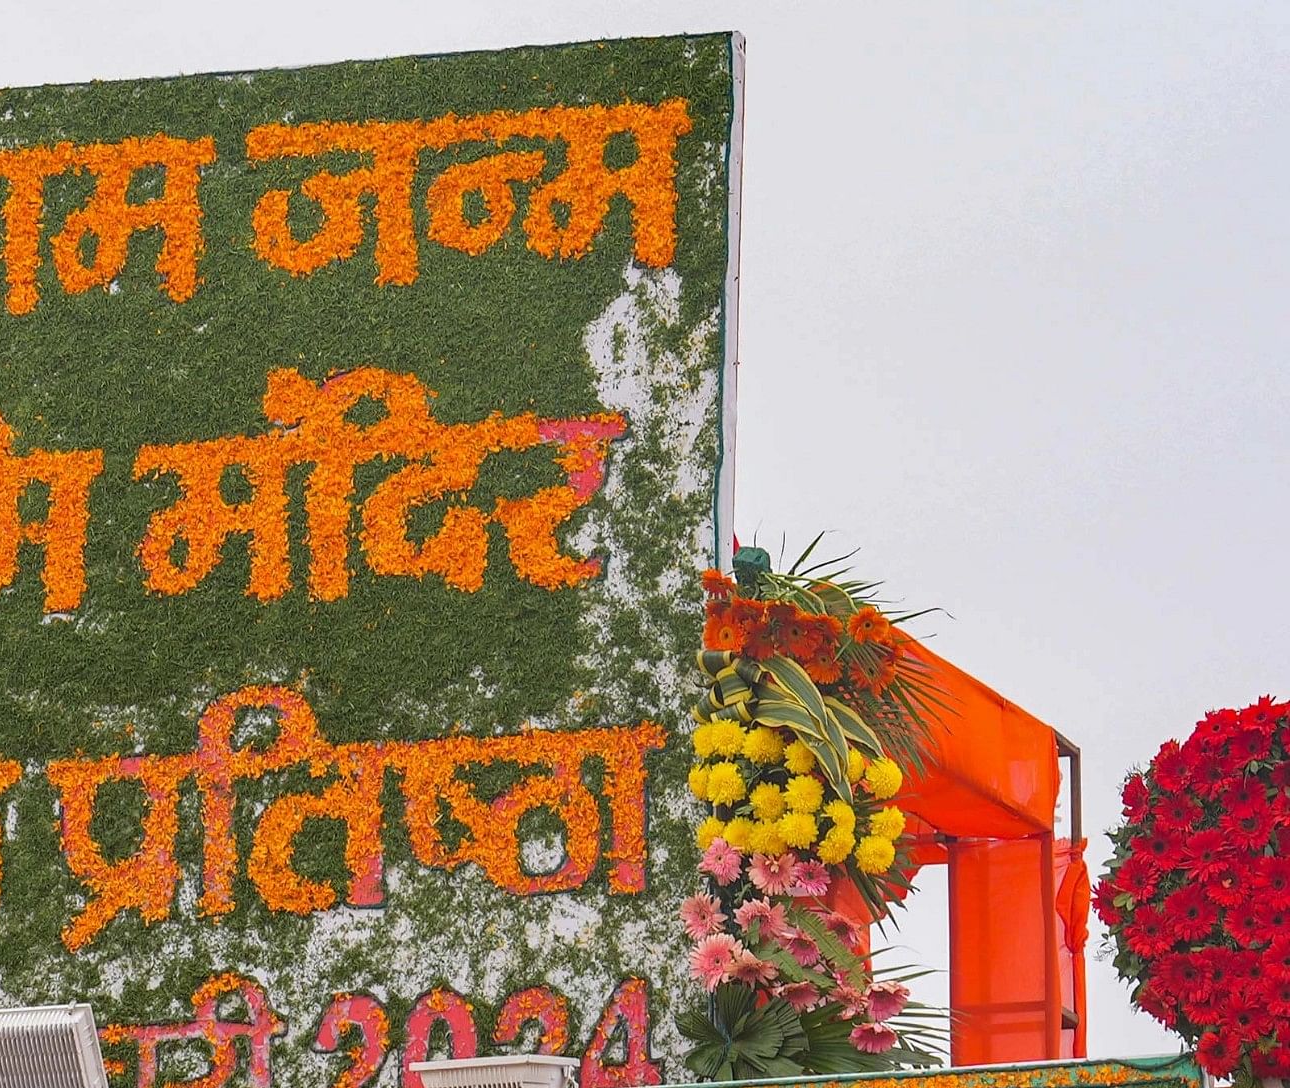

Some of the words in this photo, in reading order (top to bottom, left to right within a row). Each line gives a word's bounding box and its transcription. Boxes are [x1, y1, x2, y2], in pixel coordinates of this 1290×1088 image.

[246, 97, 691, 287] जन्म
[132, 366, 627, 601] मंदिर
[48, 684, 668, 953] प्रतिष्ठा
